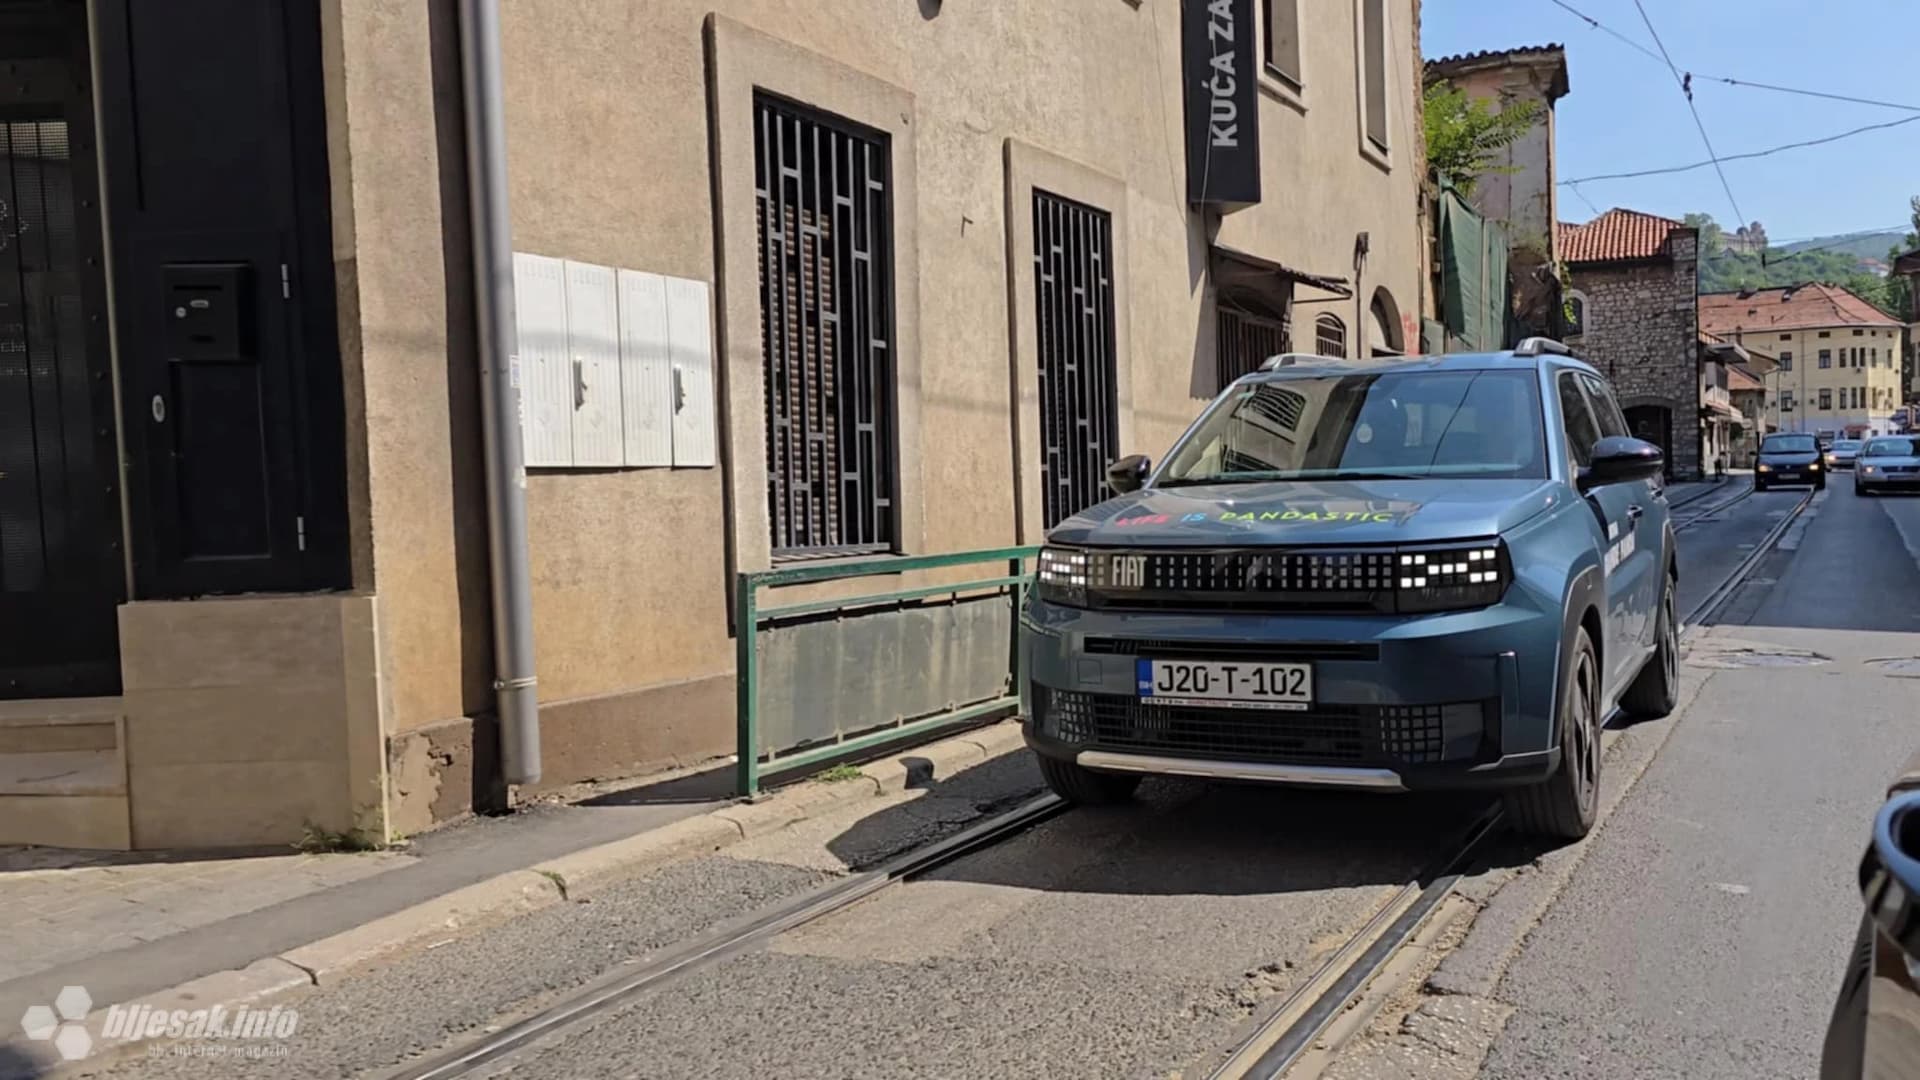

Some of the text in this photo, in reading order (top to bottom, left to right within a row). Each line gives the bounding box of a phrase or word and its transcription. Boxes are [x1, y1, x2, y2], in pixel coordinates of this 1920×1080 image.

[1202, 0, 1239, 147] KUĆA ZA
[1180, 512, 1208, 522] IS
[1219, 511, 1394, 523] PANDASTIC
[1111, 555, 1147, 587] FIAT
[1157, 665, 1307, 697] J20-T-102
